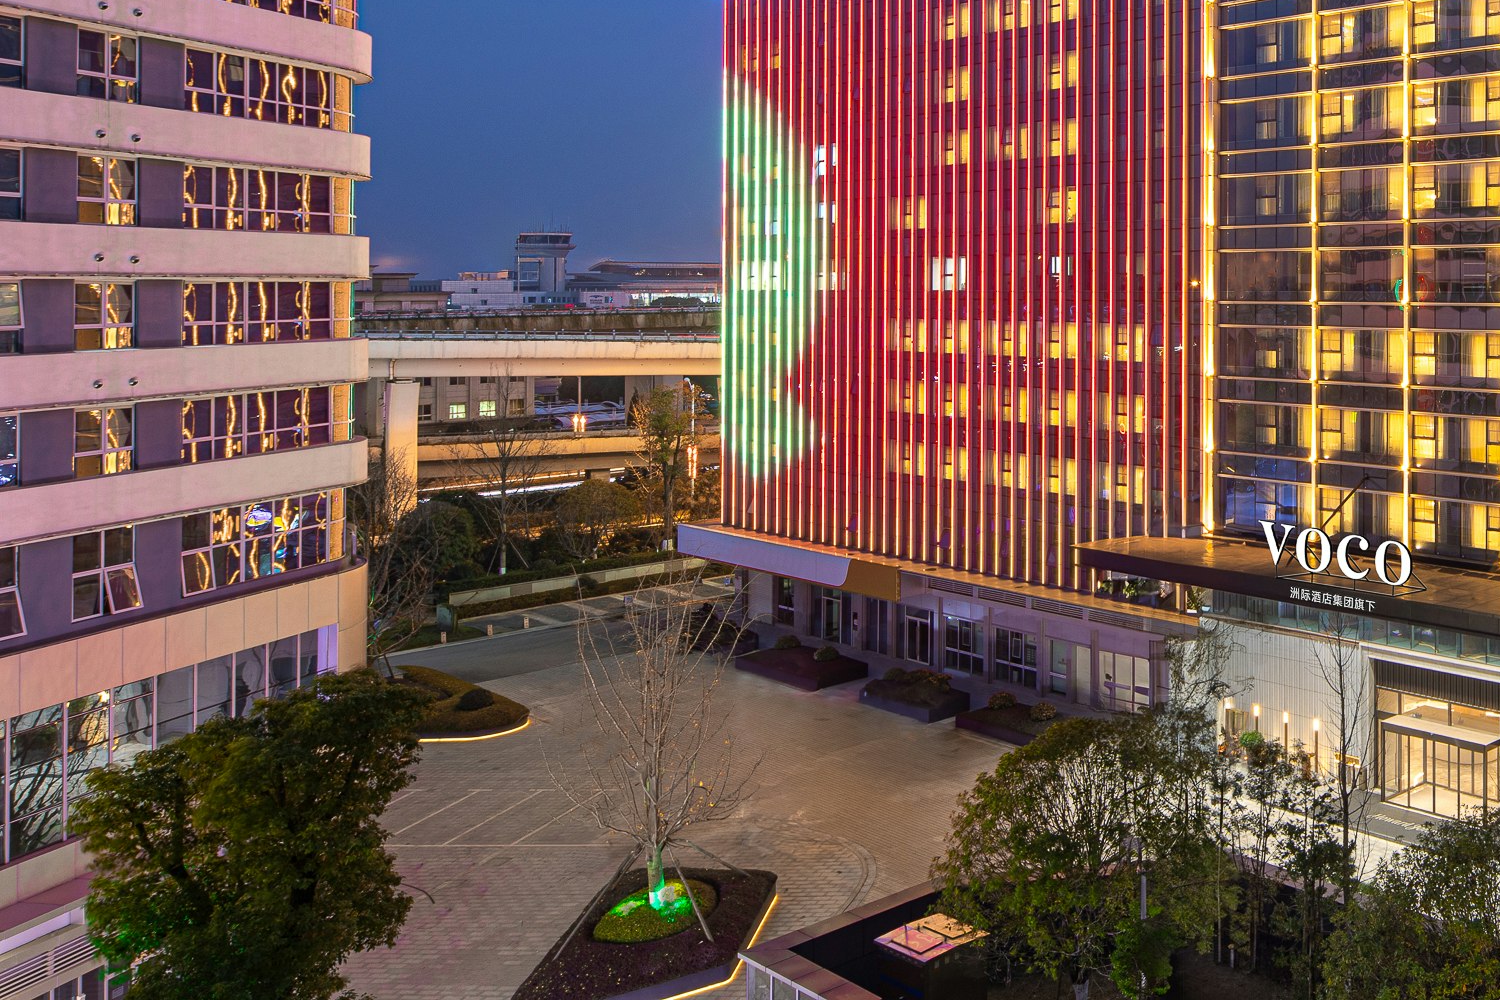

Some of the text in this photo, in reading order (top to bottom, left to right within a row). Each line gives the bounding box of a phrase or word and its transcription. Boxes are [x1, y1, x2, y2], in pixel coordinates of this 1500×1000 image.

[1289, 586, 1376, 612] 洲际酒店集团旗下
